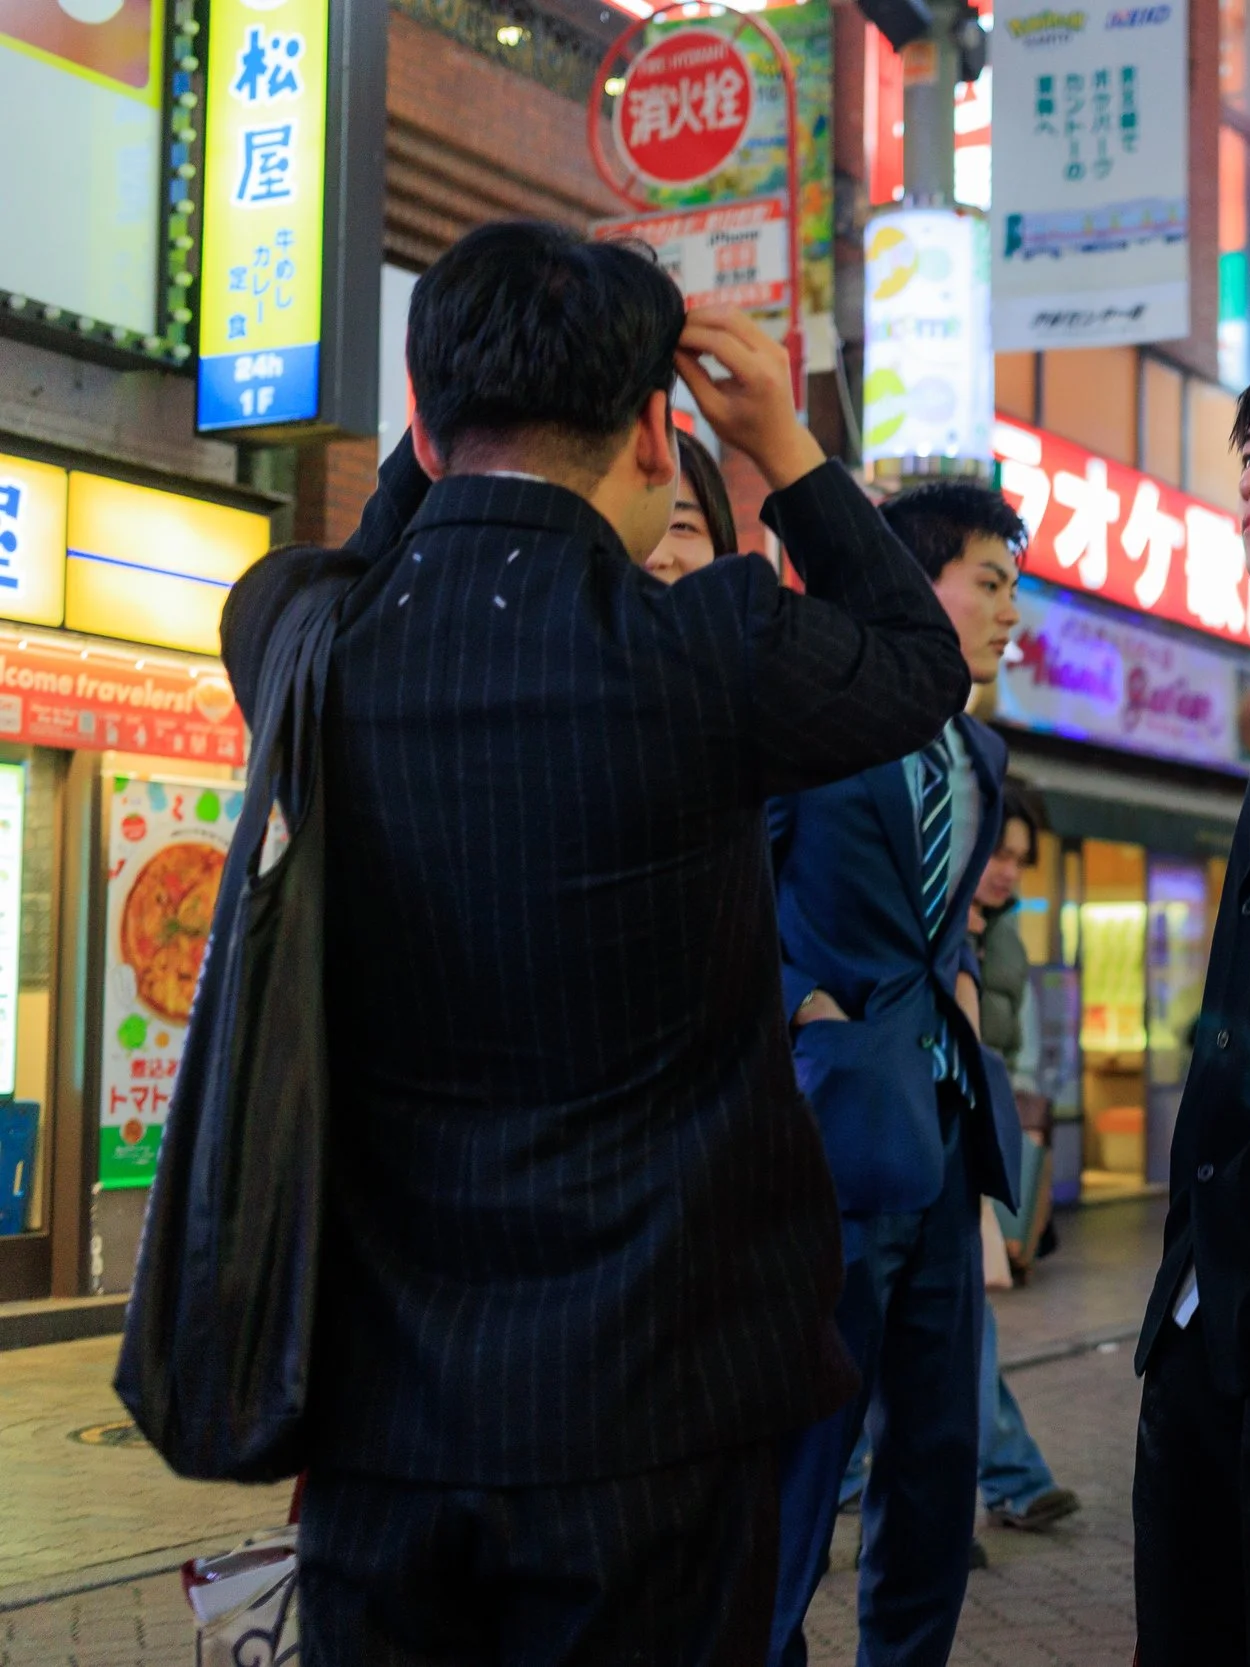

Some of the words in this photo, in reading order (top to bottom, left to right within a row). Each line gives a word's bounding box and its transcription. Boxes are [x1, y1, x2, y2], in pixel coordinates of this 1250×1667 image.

[234, 28, 300, 203] 松屋
[627, 66, 745, 148] 消火栓
[227, 267, 248, 340] 定食
[252, 245, 272, 324] カレー
[274, 228, 296, 309] 牛めし
[234, 354, 283, 382] 24h
[239, 386, 275, 416] 1F
